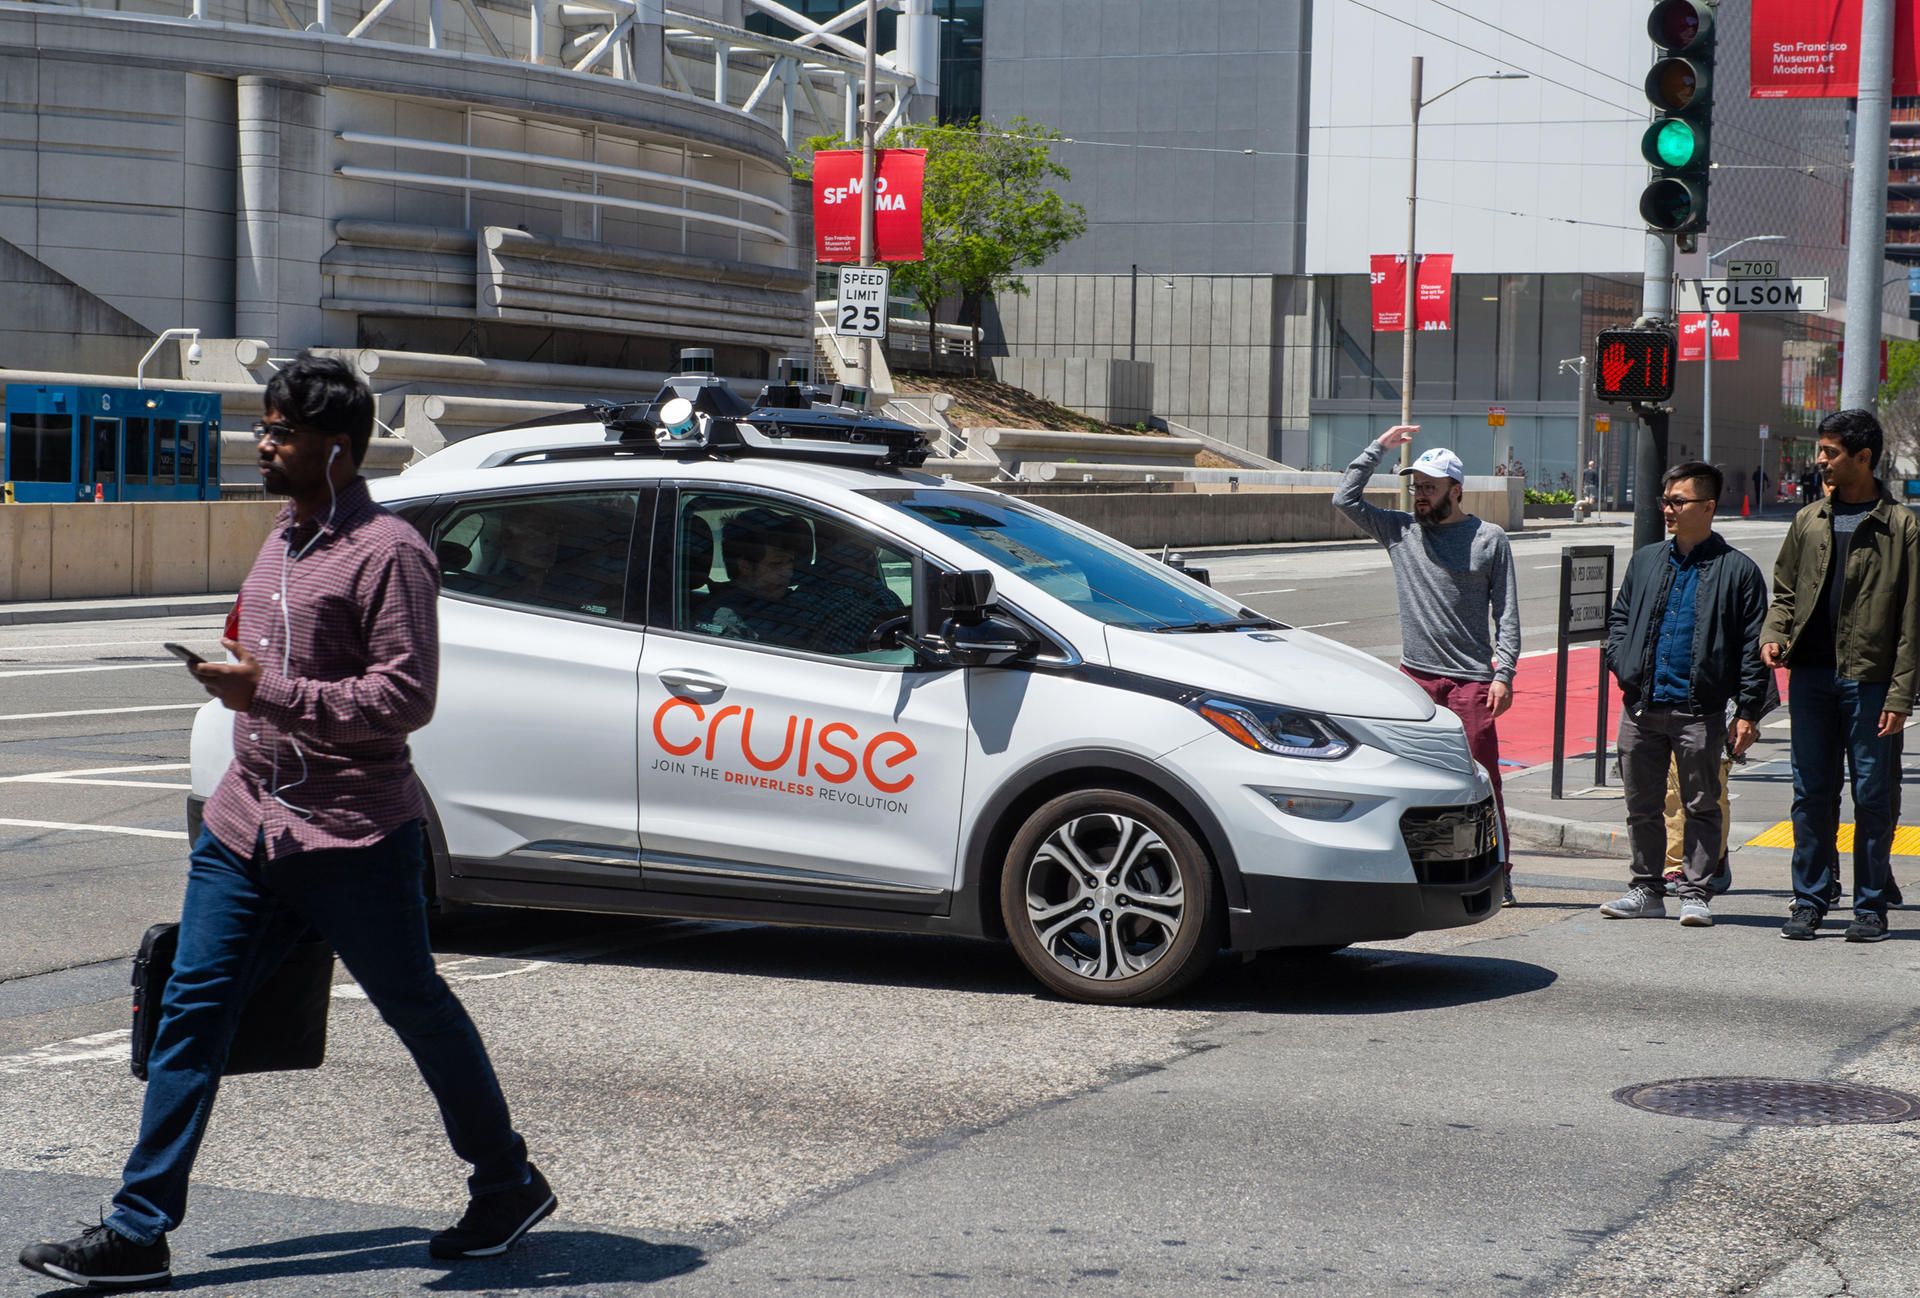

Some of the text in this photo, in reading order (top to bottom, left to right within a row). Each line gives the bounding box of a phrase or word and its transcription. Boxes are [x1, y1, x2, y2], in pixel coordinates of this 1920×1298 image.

[1773, 41, 1848, 53] San Francisco
[1773, 52, 1834, 63] Museum of
[1773, 63, 1835, 74] Modern Art
[823, 187, 848, 205] SF
[874, 194, 906, 211] MA
[1744, 262, 1773, 275] 700
[843, 273, 884, 286] SPEED
[1370, 272, 1386, 284] SF
[846, 290, 878, 301] LIMIT
[1701, 286, 1802, 305] FOLSOM
[841, 305, 880, 331] 25
[1684, 324, 1697, 334] SF
[1711, 327, 1730, 337] MA
[653, 696, 918, 793] cruise
[651, 758, 908, 814] JOIN THE DRIVERLESS REVOLUTION
